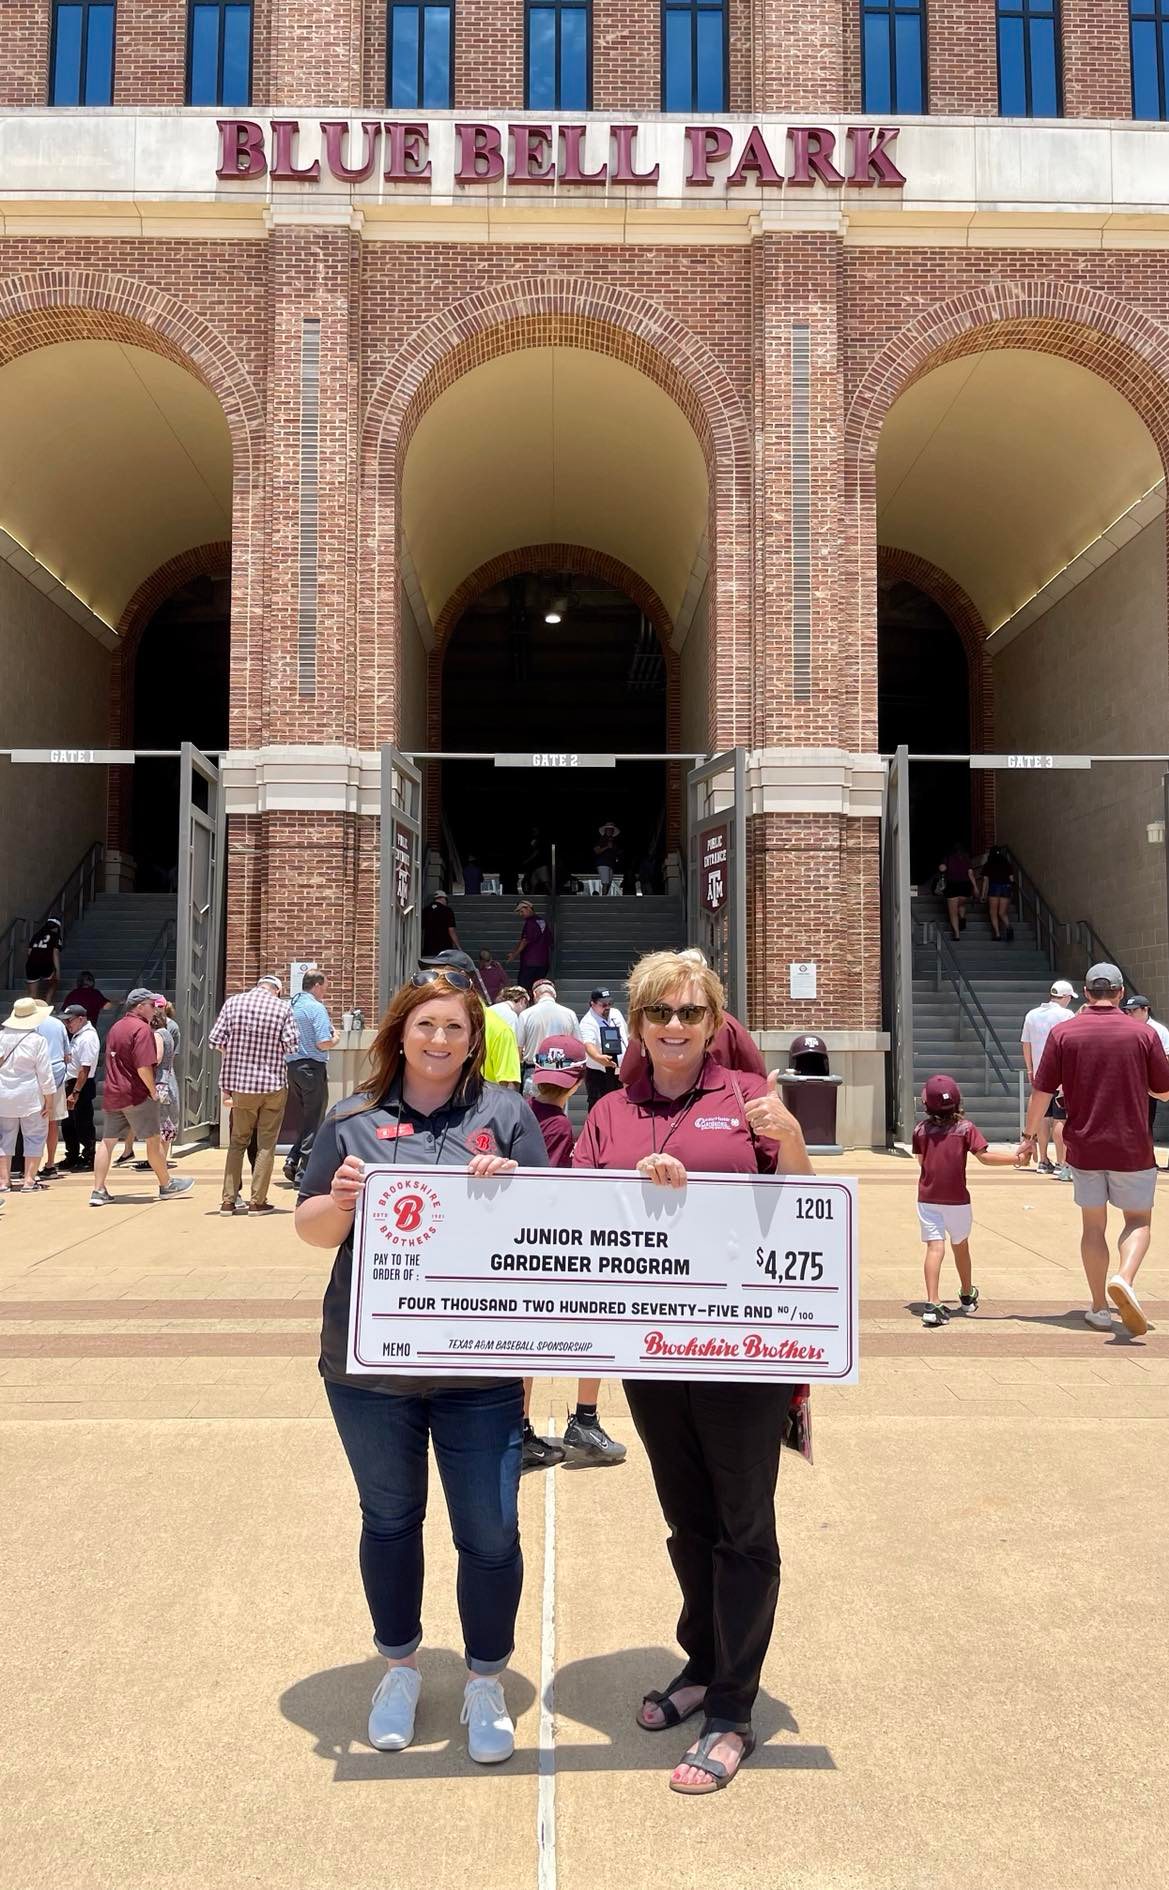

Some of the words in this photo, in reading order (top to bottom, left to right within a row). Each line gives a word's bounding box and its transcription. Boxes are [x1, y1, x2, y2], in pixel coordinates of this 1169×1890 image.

[216, 120, 432, 183] BLUE
[454, 123, 660, 186] BELL
[685, 125, 907, 187] PARK
[50, 750, 85, 762] GATE
[89, 750, 95, 762] 1
[532, 754, 567, 767] GATE
[570, 754, 578, 767] 2
[1007, 755, 1042, 768] GATE
[1046, 755, 1053, 768] 3
[707, 835, 723, 851] PUBLIC
[703, 849, 727, 868] ENTRANCE
[378, 1180, 441, 1208] BROOKSHIRE
[393, 1194, 425, 1233] B
[795, 1197, 834, 1220] 1201
[379, 1225, 437, 1247] BROTHERS
[513, 1228, 583, 1246] JUNIOR
[590, 1229, 668, 1248] MASTER
[373, 1253, 389, 1266] PAY
[391, 1253, 402, 1266] TO
[405, 1254, 420, 1266] THE
[490, 1253, 592, 1272] GARDENER
[598, 1256, 690, 1275] PROGRAM
[756, 1246, 824, 1284] $4,275
[372, 1268, 400, 1281] ORDER
[398, 1296, 436, 1310] FOUR
[440, 1297, 518, 1312] THOUSAND
[523, 1299, 554, 1313] TWO
[560, 1300, 626, 1315] HUNDRED
[631, 1302, 739, 1318] SEVENTY-FIVE
[744, 1305, 773, 1319] AND
[382, 1342, 411, 1357] MEMO
[448, 1339, 474, 1349] TEXAS
[474, 1340, 495, 1350] A&M
[495, 1340, 535, 1351] BASEBALL
[536, 1341, 593, 1352] SPONSORSHIP
[643, 1331, 740, 1358] Brookshire
[742, 1334, 825, 1360] Brothers
